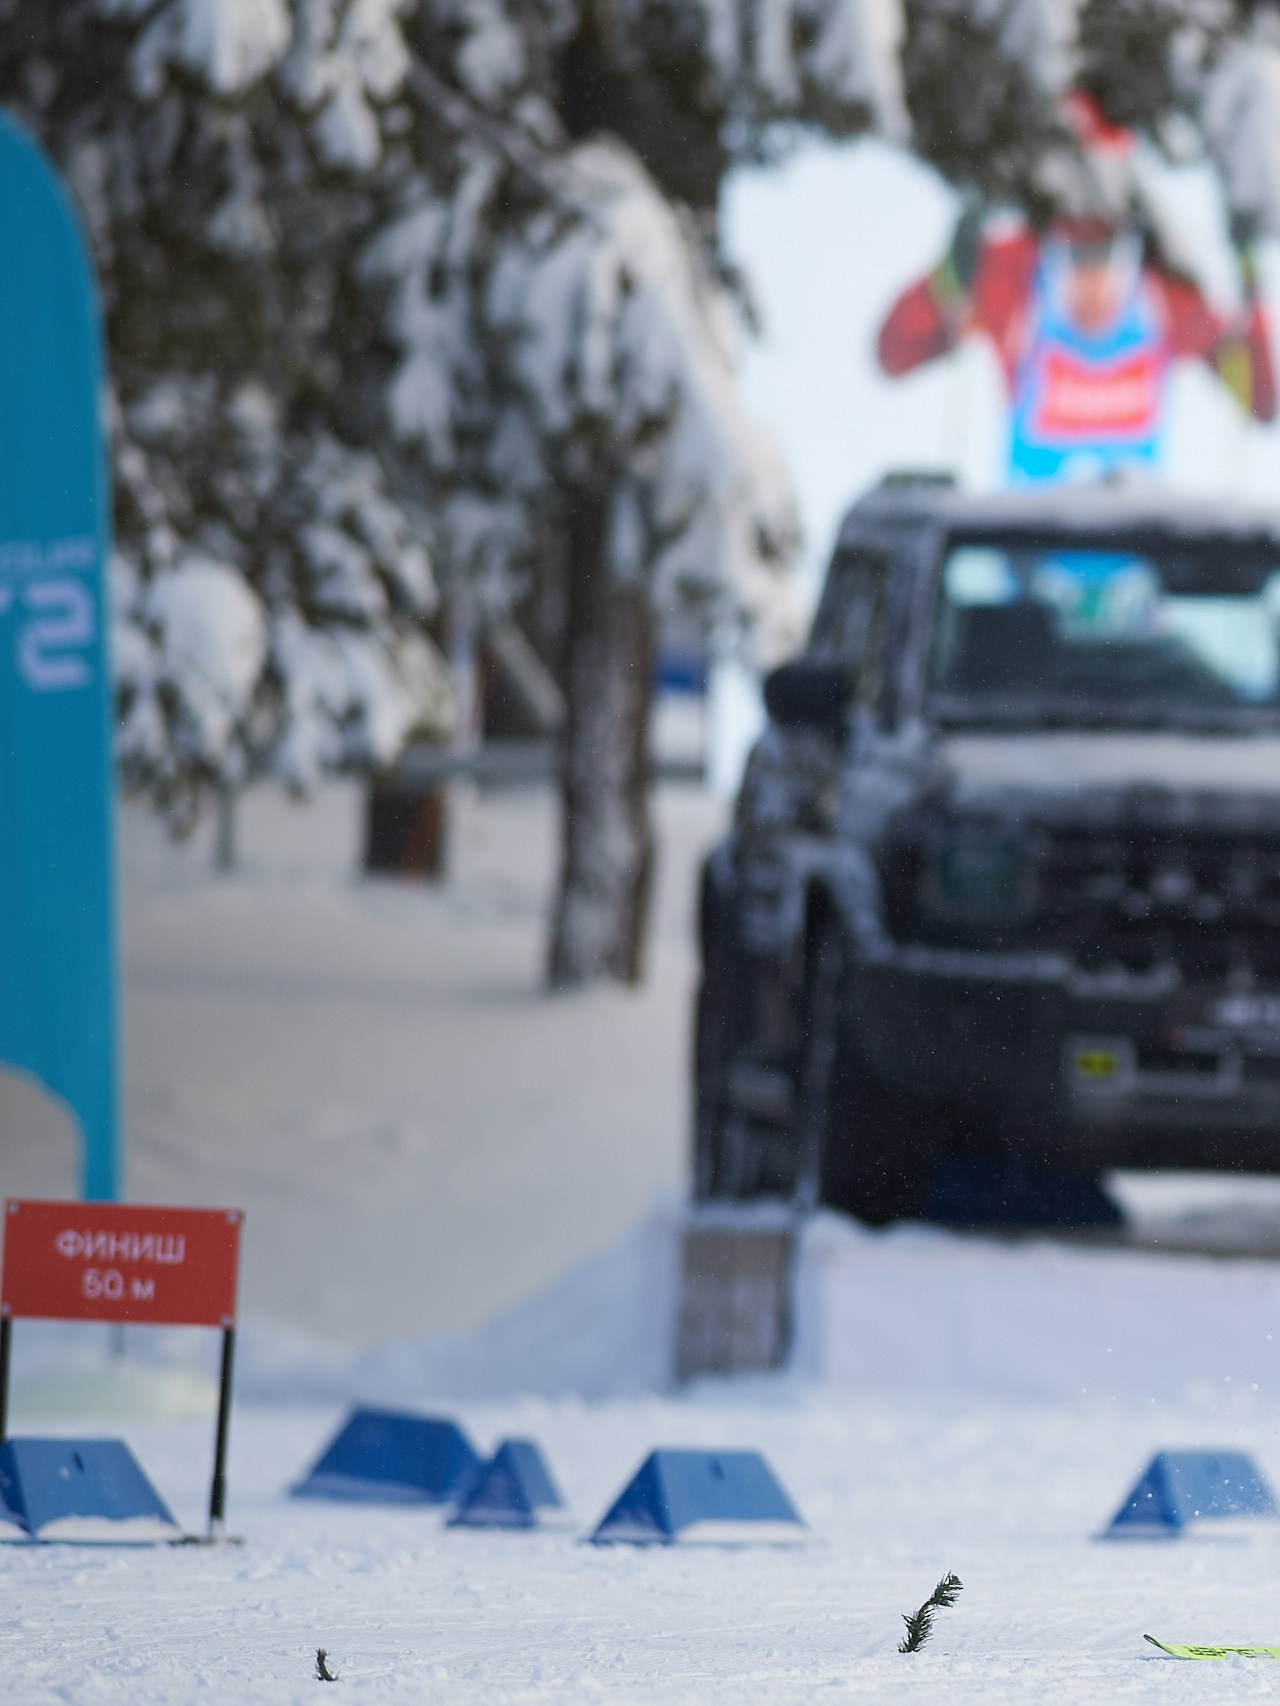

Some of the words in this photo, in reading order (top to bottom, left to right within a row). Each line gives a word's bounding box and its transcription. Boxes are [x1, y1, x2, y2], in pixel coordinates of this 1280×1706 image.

[55, 1228, 186, 1264] ФИНИШ
[82, 1267, 124, 1300] 50
[132, 1277, 155, 1300] м
